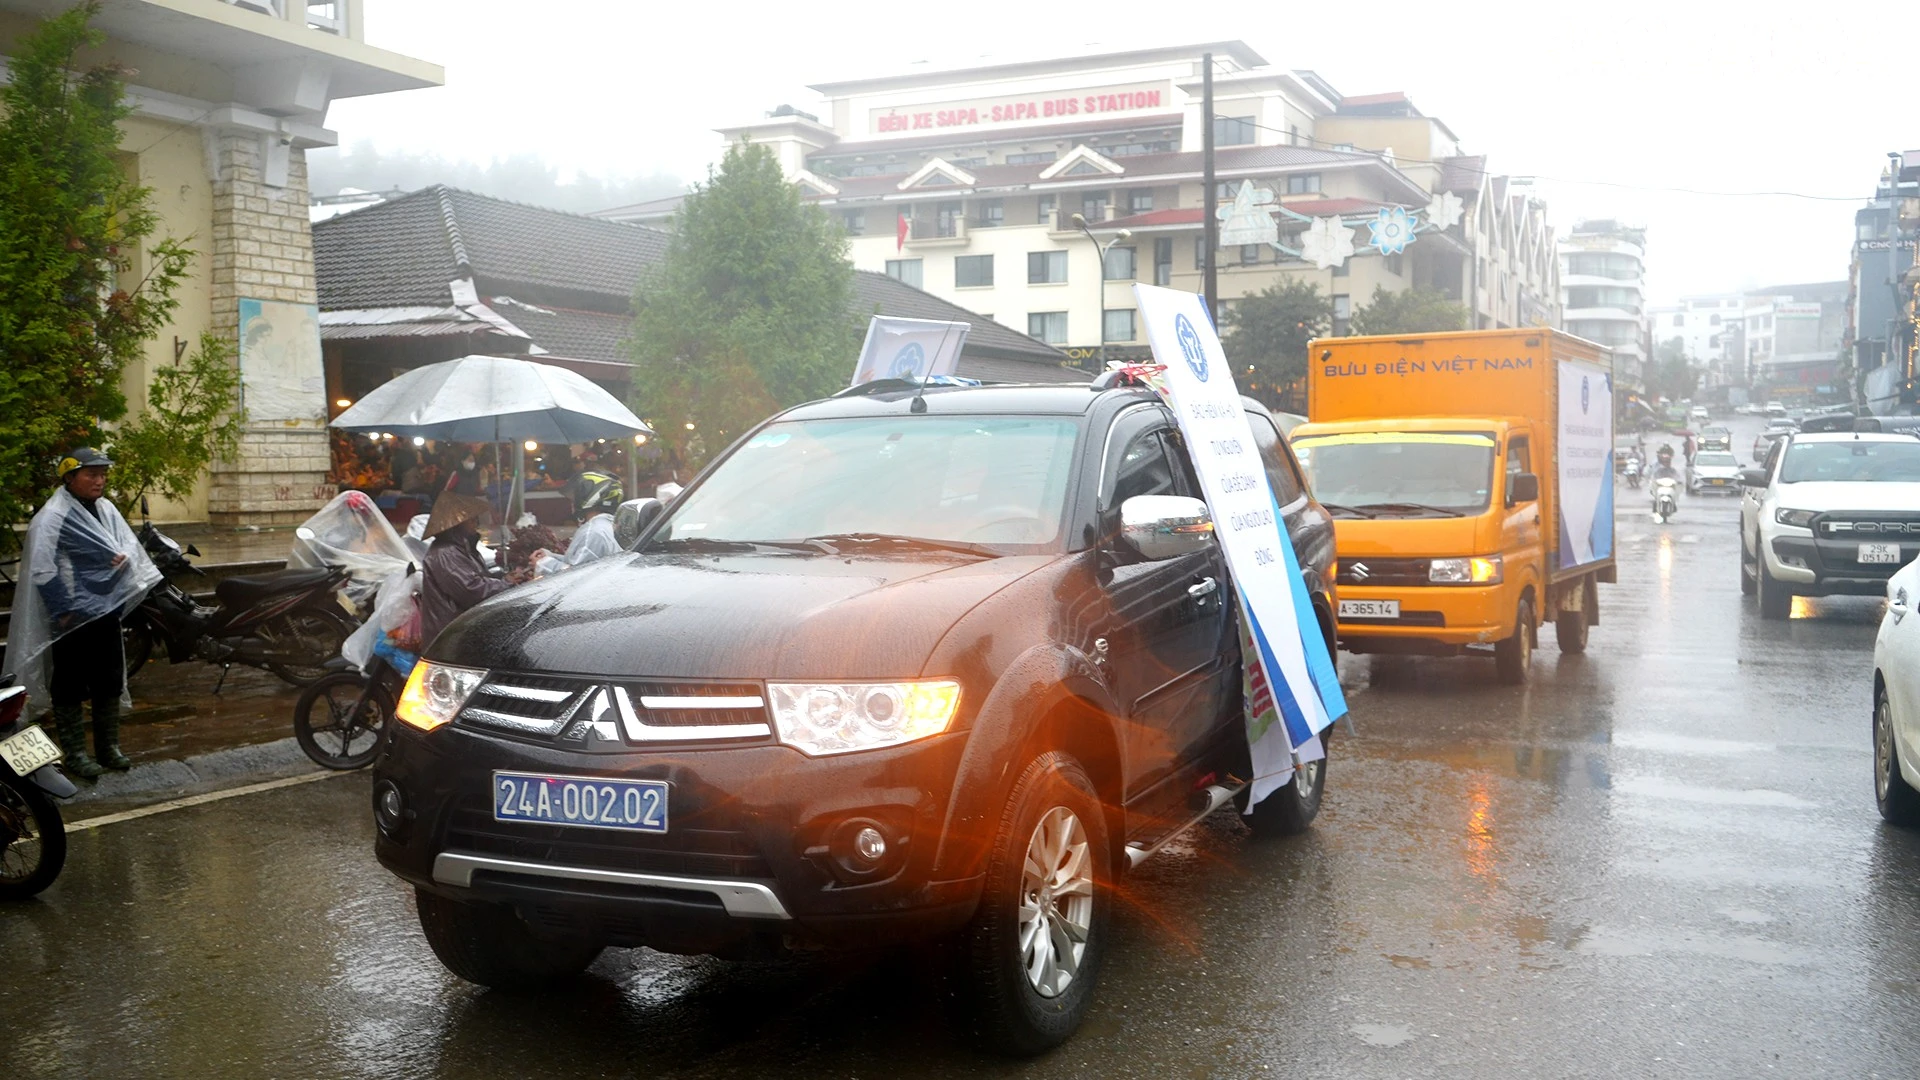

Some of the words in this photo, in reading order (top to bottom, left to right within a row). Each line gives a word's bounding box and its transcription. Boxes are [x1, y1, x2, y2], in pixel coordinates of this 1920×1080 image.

[913, 112, 932, 129] XE
[936, 107, 978, 127] SAPA
[991, 102, 1038, 122] SAPA
[1043, 98, 1079, 117] BUS
[1084, 90, 1161, 113] STATION
[1324, 361, 1367, 377] BƯU
[1374, 357, 1426, 377] ĐIỆN
[1431, 354, 1477, 375] VIỆT
[1483, 357, 1533, 371] NAM
[1862, 554, 1896, 562] 051.71
[4, 731, 42, 757] 24-B2
[13, 743, 57, 772] 963.33
[500, 779, 660, 826] 24A-002.02
